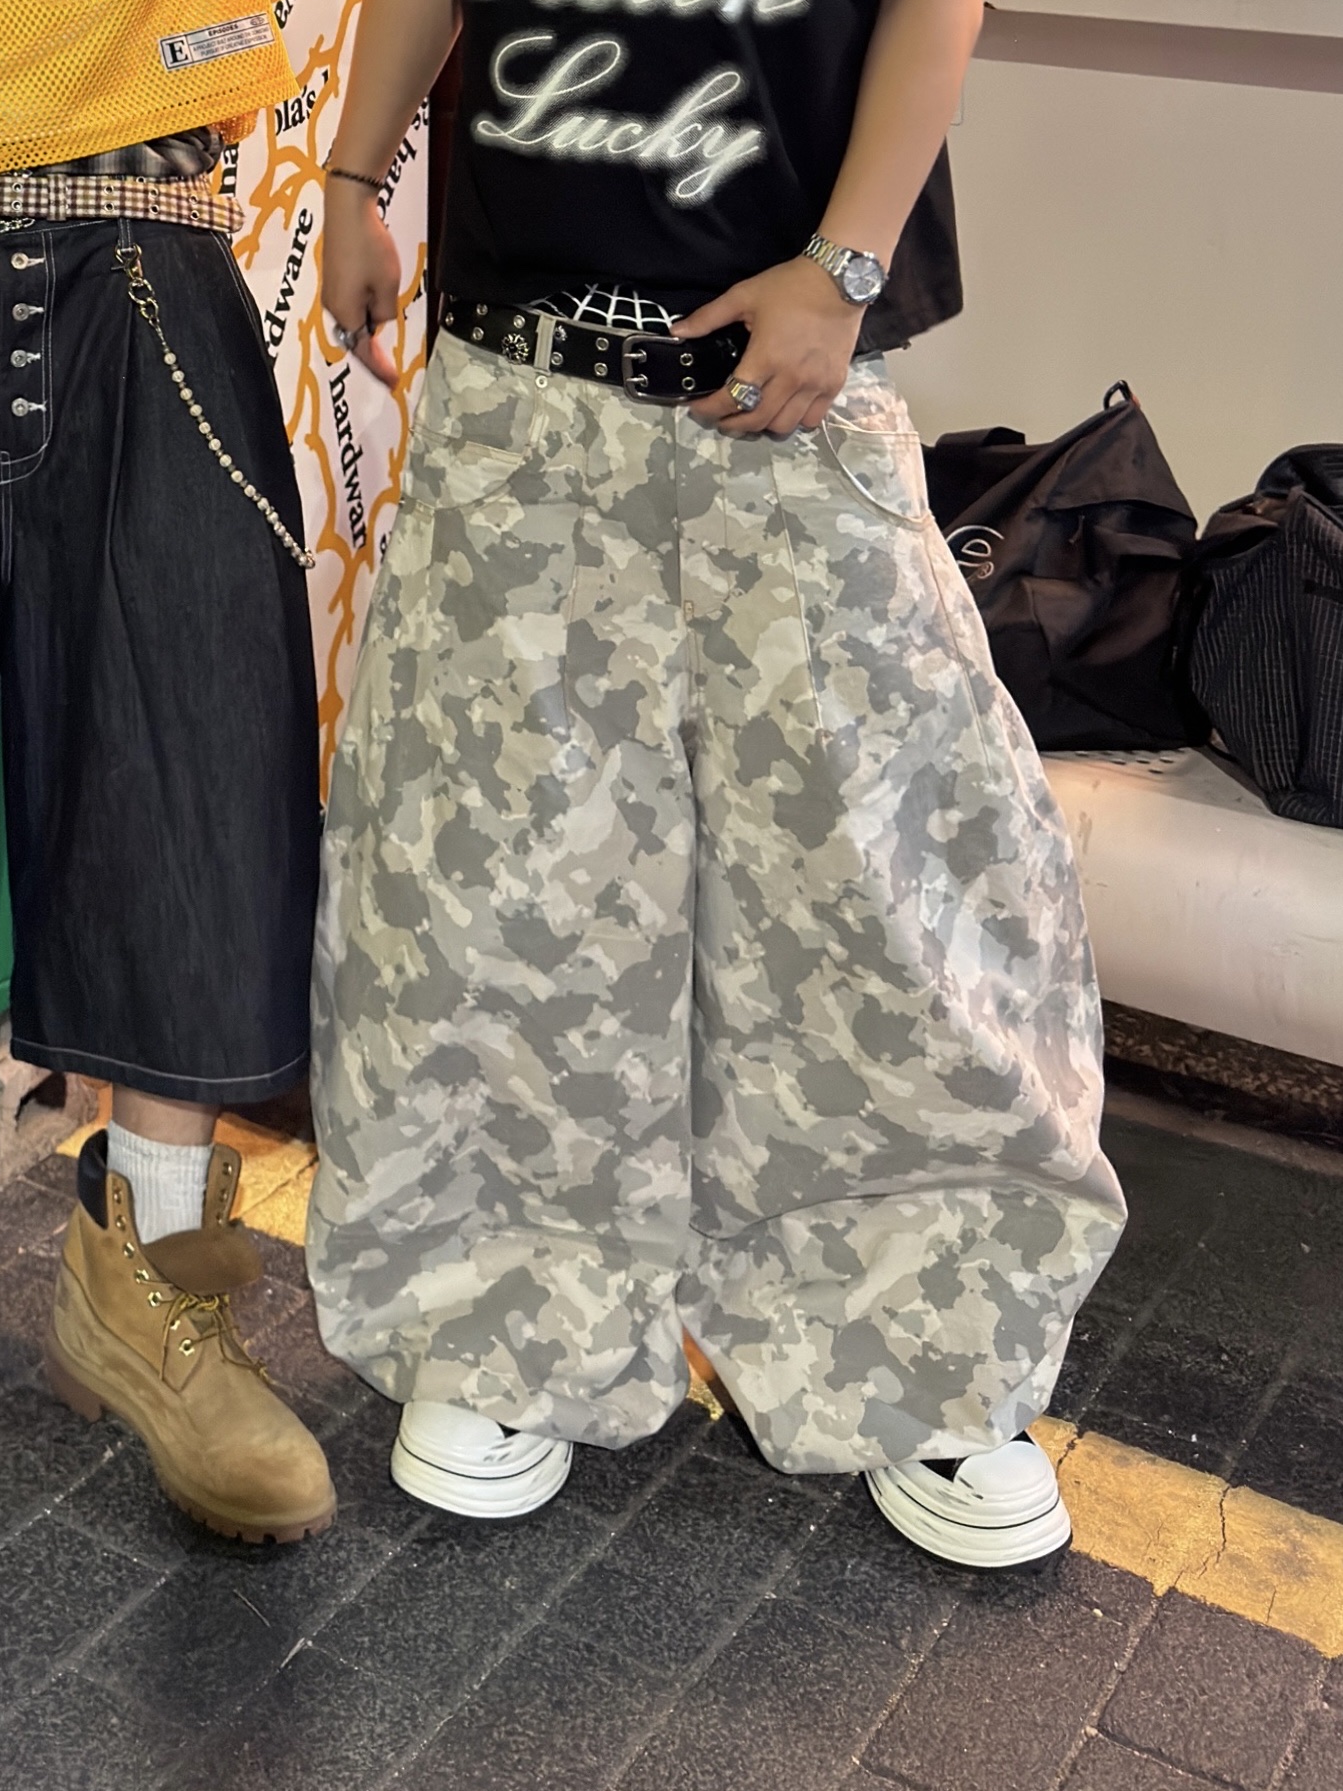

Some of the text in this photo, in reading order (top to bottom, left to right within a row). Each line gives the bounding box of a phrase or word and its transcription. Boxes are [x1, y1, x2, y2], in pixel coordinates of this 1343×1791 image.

[165, 39, 188, 64] E
[476, 36, 761, 199] Lucky
[265, 207, 314, 372] rdware
